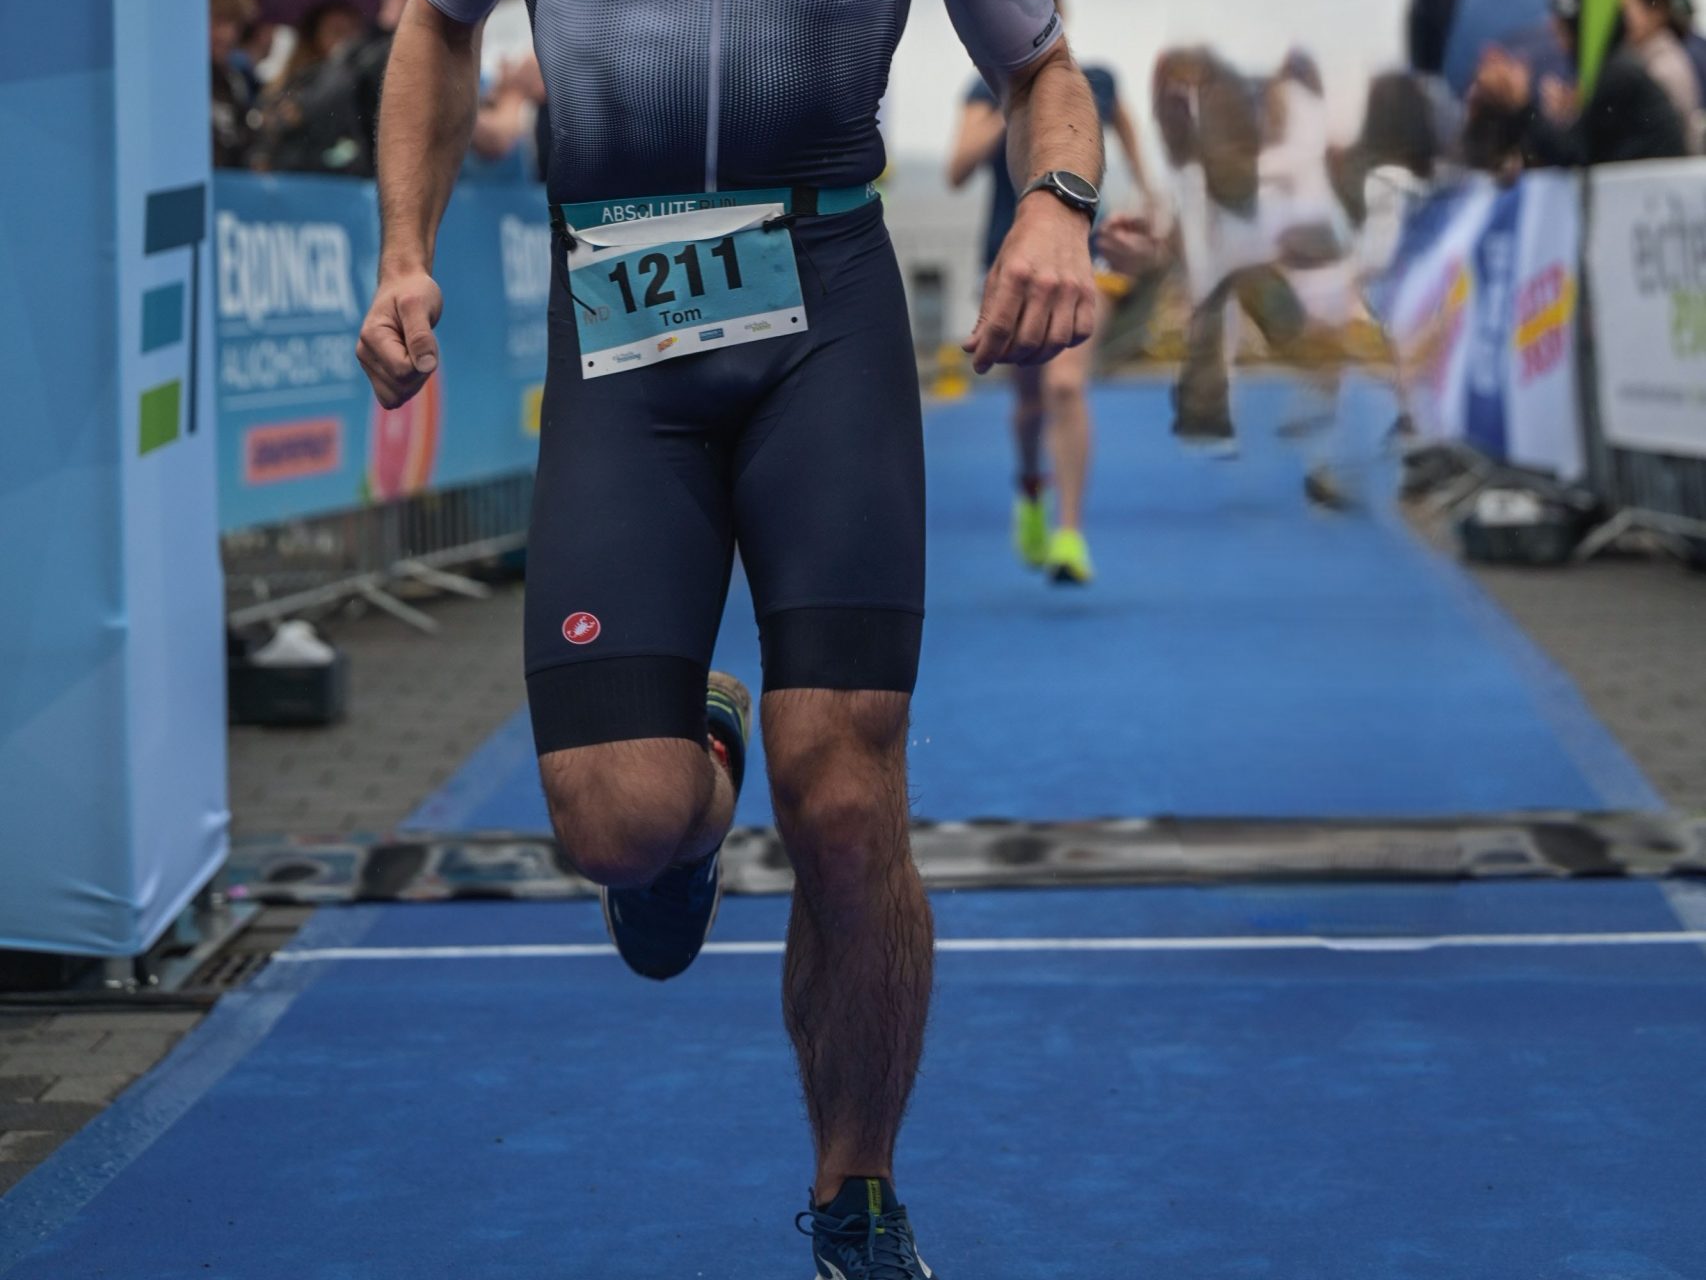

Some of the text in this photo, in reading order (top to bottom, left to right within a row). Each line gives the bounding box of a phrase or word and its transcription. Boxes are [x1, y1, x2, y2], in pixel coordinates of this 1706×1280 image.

[602, 201, 697, 223] ABSOLUTE
[608, 237, 742, 313] 1211
[659, 307, 702, 326] Tom
